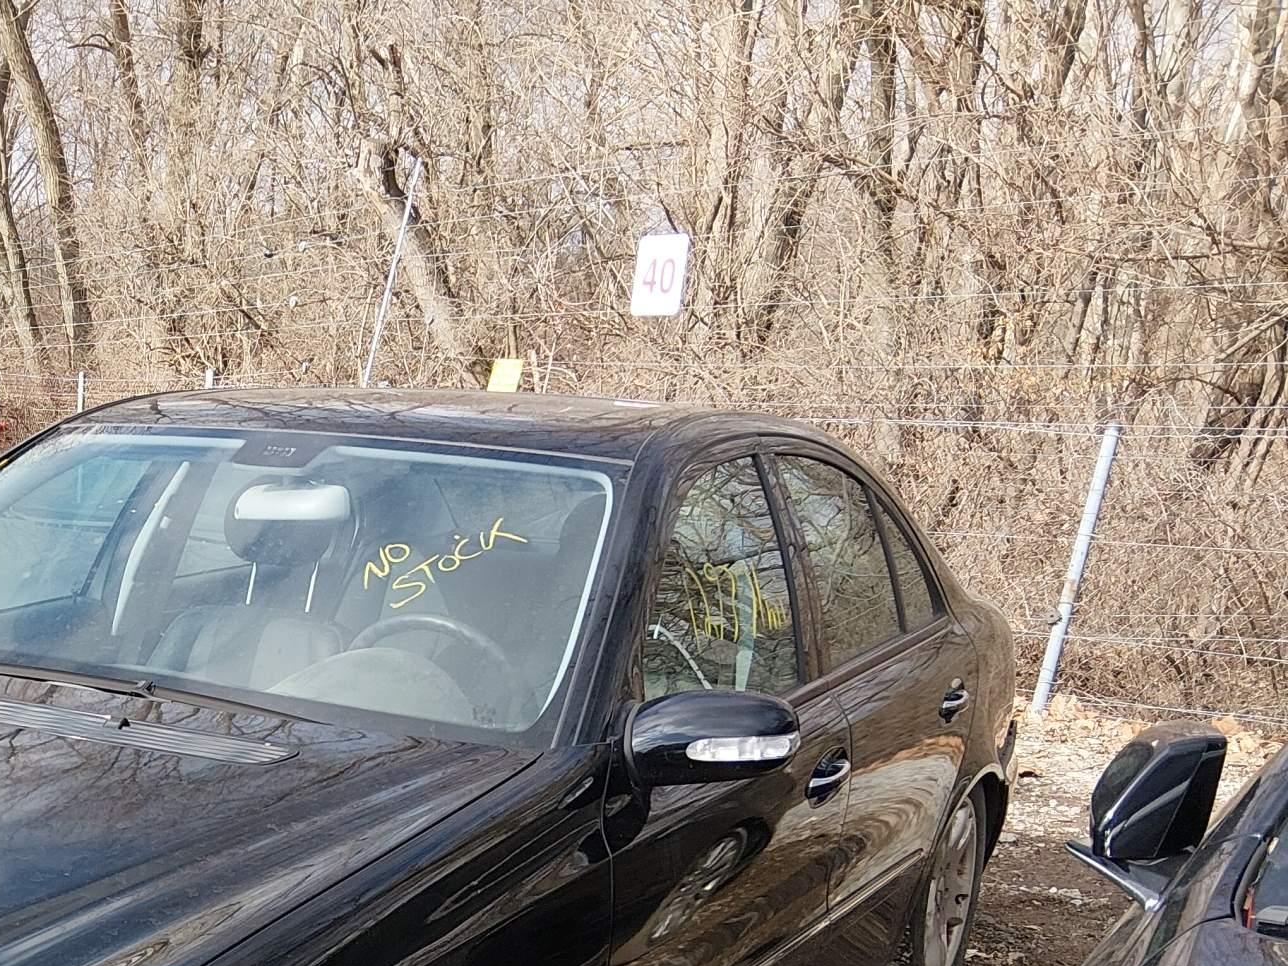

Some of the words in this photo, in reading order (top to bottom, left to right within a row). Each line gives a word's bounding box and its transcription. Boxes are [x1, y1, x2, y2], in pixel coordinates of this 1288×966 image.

[641, 257, 676, 294] 40
[363, 543, 411, 590] NO
[389, 517, 529, 609] STOCK
